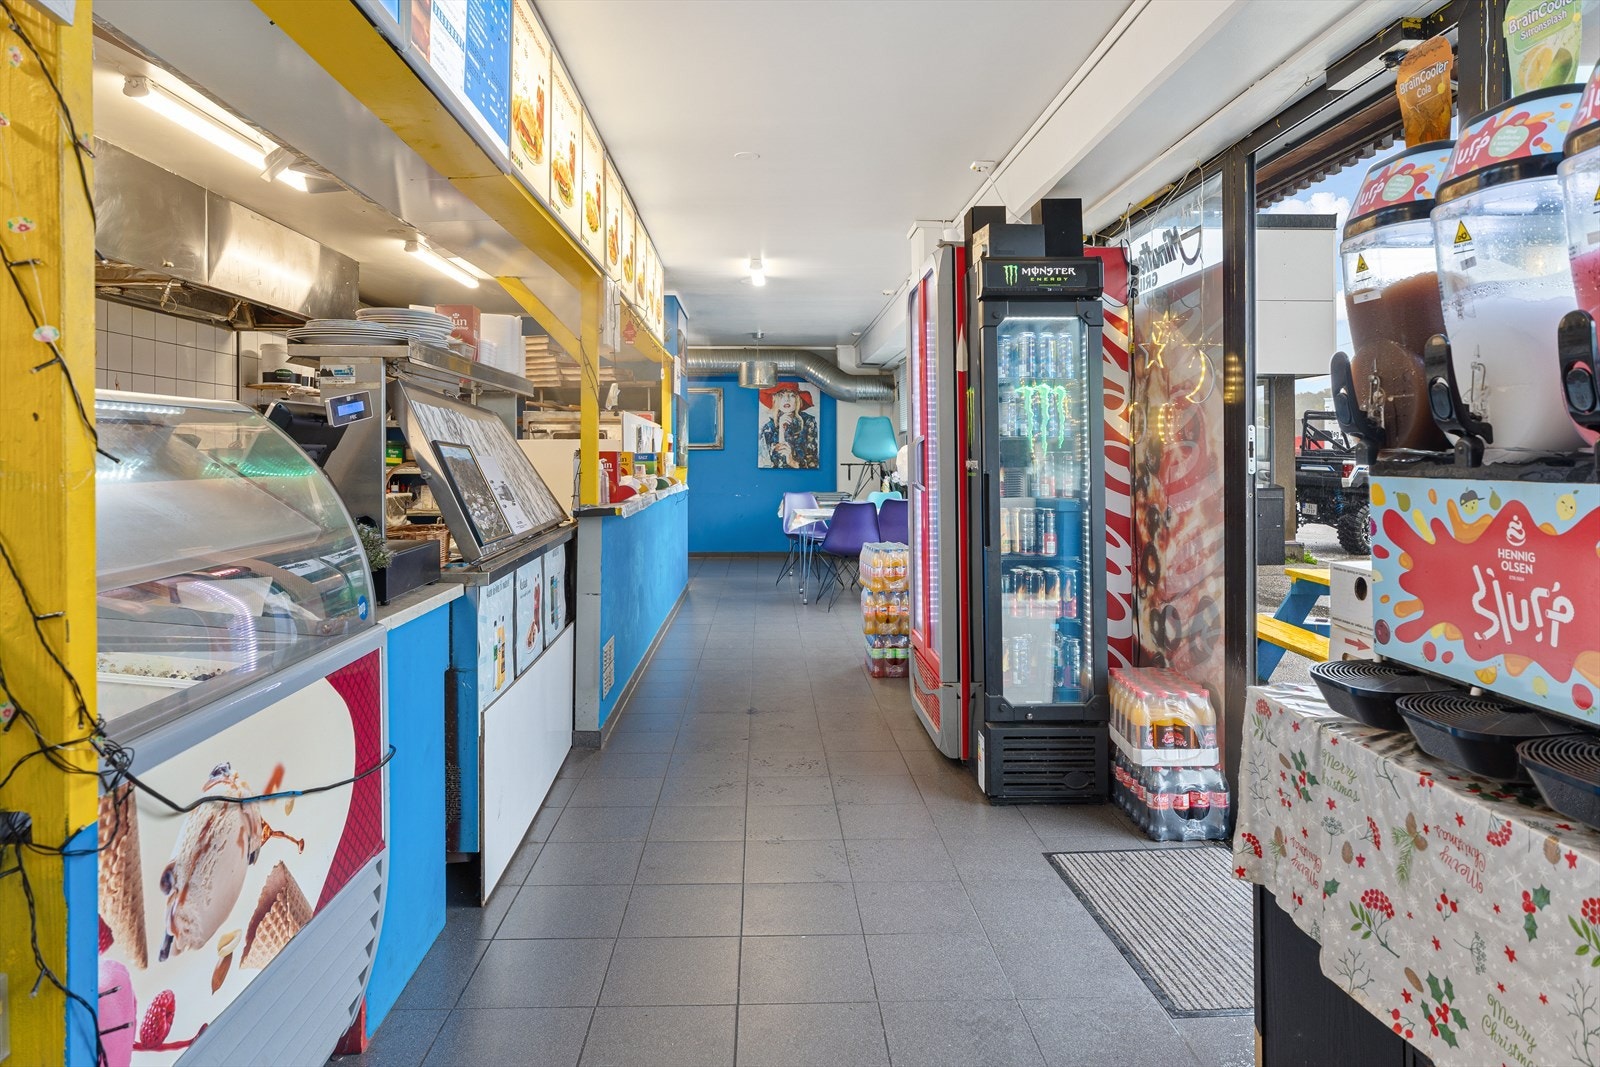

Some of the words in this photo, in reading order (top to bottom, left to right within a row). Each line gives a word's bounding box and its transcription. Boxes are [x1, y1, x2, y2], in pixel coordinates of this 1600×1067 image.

[1520, 10, 1567, 40] Sitronsplash
[1399, 60, 1449, 95] BrainCooler
[1416, 84, 1432, 98] Cola
[1452, 131, 1490, 174] lurp
[1021, 266, 1076, 277] MONSTER
[1497, 548, 1536, 563] HENNIG
[1501, 561, 1534, 575] OLSEN
[1472, 564, 1575, 648] Slurp
[1321, 749, 1357, 784] Merry
[1322, 768, 1360, 802] hristmas
[1290, 837, 1323, 874] Christmas
[1434, 825, 1486, 873] Christmas
[1291, 853, 1319, 890] Merry
[1440, 846, 1483, 894] Merry
[1482, 1014, 1538, 1067] Christma
[1487, 993, 1537, 1054] Merry
